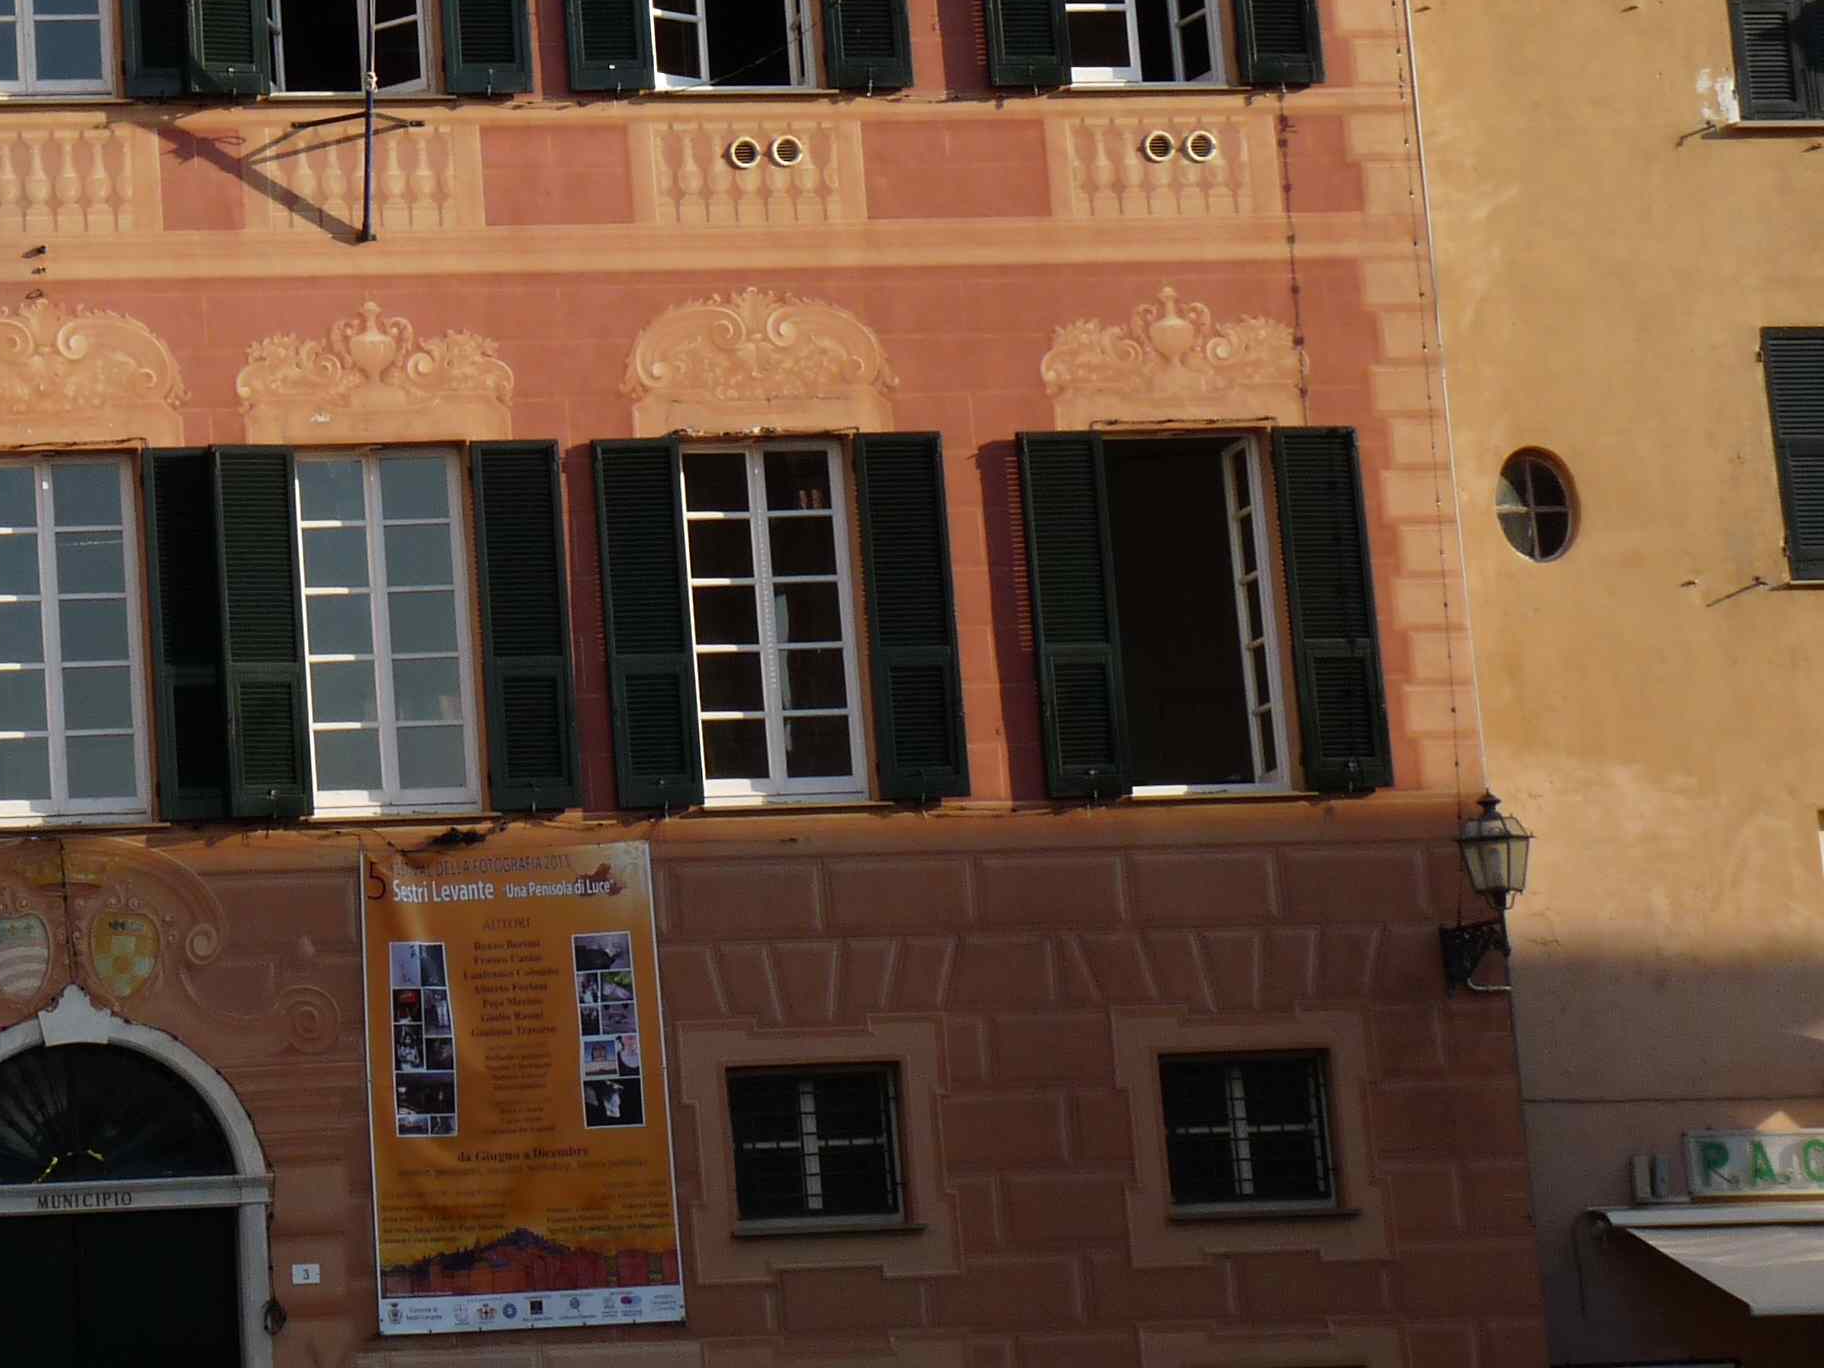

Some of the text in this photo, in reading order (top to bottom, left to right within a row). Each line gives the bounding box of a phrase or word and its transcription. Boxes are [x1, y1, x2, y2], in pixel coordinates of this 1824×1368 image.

[367, 861, 386, 900] 5
[392, 879, 429, 903] Sestri
[432, 879, 495, 902] Levante
[528, 879, 573, 896] Penisola
[574, 878, 585, 895] di
[37, 1192, 132, 1209] MUNICIPIO
